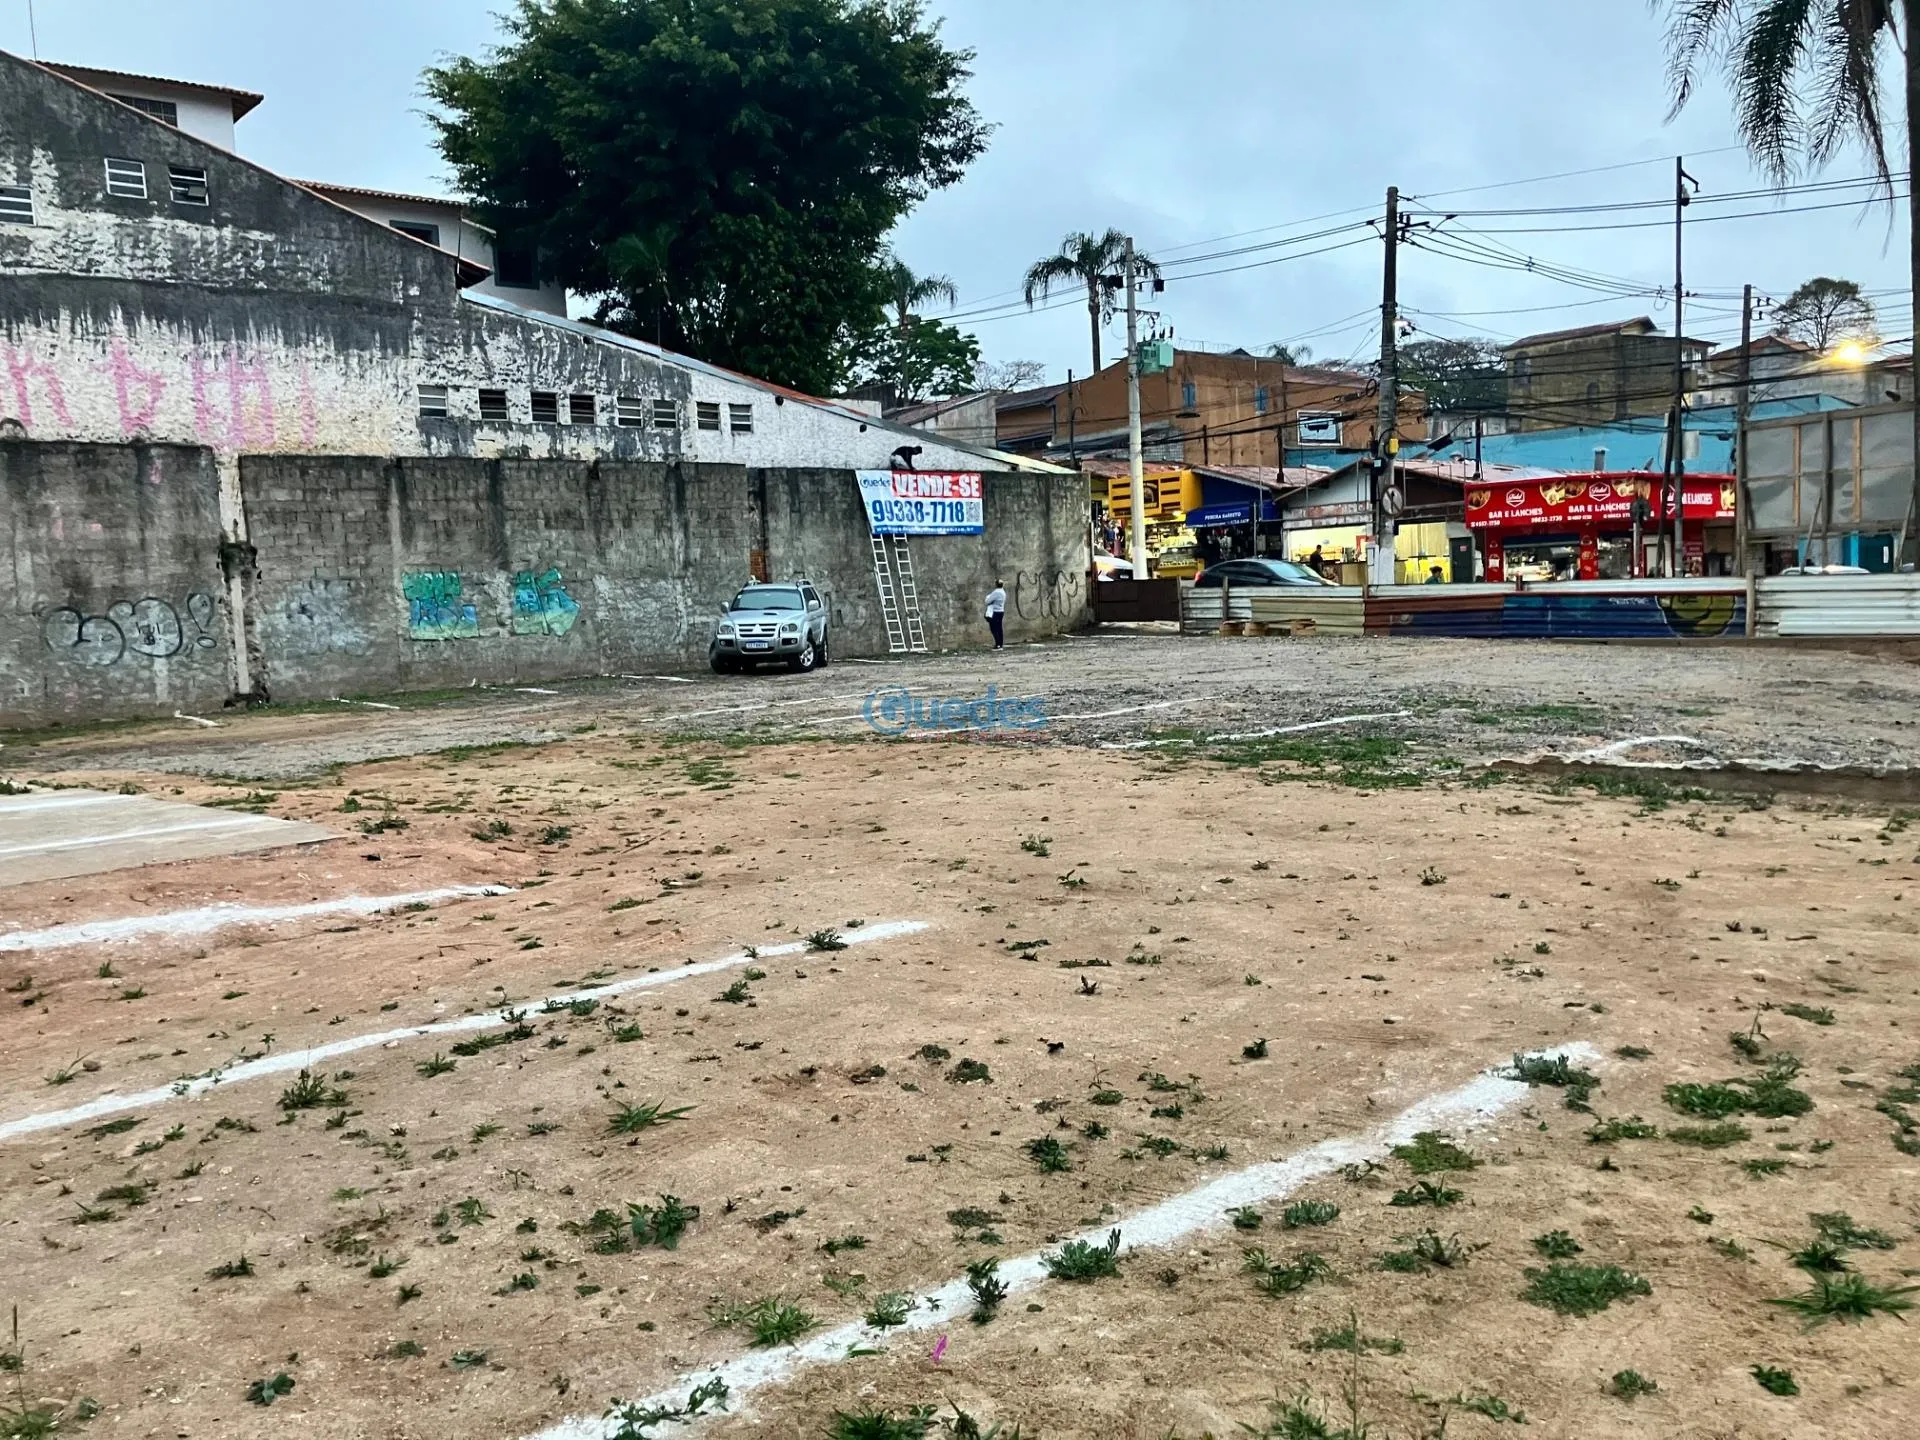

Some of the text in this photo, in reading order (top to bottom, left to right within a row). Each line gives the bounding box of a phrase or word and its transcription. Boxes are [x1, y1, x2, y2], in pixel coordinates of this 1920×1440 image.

[893, 473, 980, 497] VENDE-SE
[871, 500, 965, 523] 99338-7718
[1488, 508, 1543, 519] BAR E LANCHES
[1568, 502, 1631, 513] BAR E LANCHES
